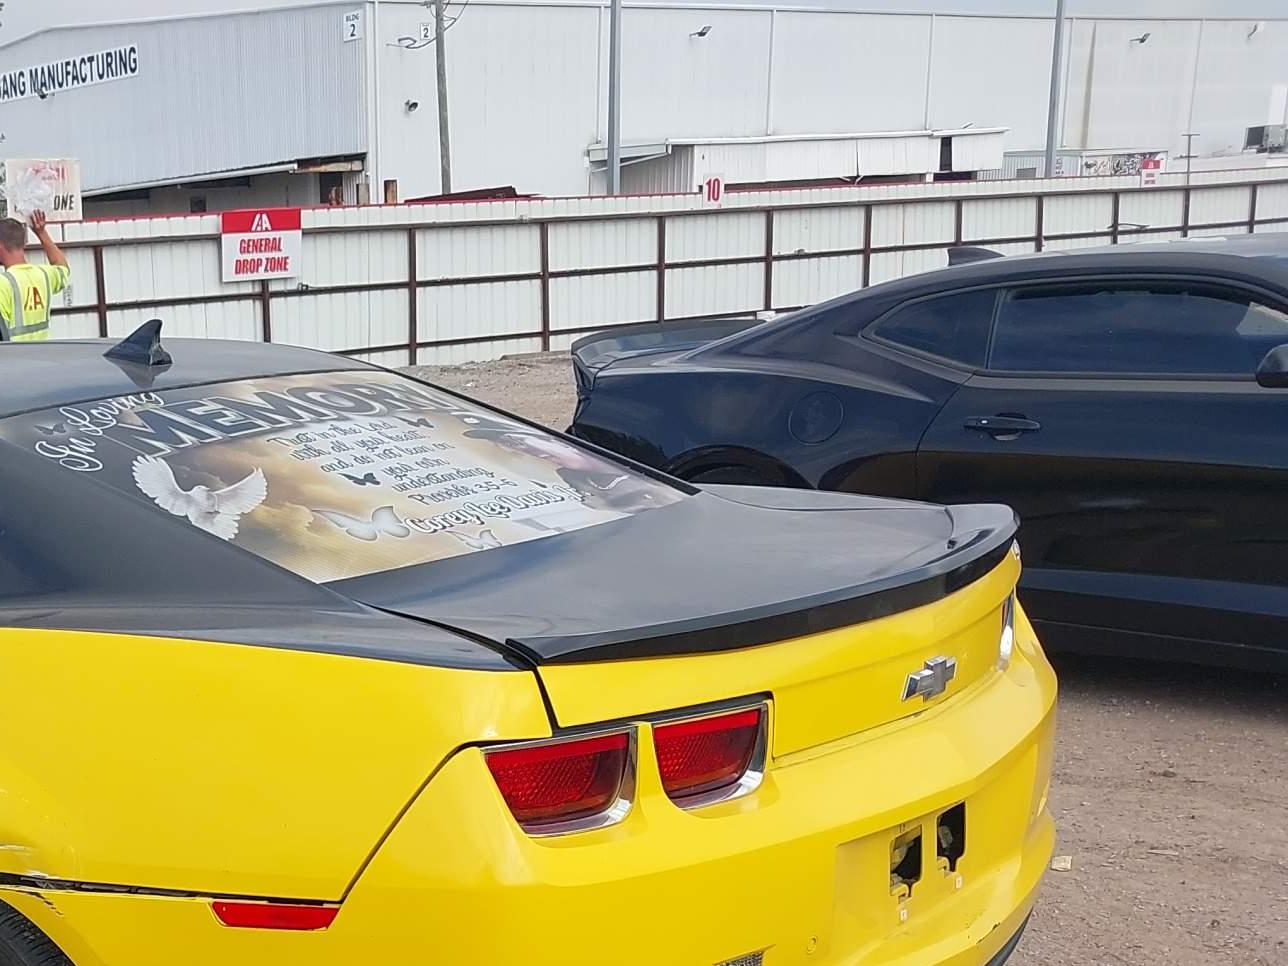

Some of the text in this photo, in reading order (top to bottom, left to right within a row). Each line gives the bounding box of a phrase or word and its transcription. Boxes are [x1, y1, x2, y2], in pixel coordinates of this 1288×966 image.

[350, 24, 356, 37] 2
[423, 27, 429, 38] 2
[28, 46, 139, 94] MANUFACTURING
[705, 177, 721, 202] 10
[239, 237, 282, 254] GENERAL
[235, 256, 289, 275] DROP ZONE
[35, 391, 165, 472] In Loving
[105, 384, 459, 459] MEMORY
[266, 432, 316, 447] Trust
[328, 424, 362, 437] the
[353, 421, 398, 432] Lord
[290, 444, 331, 460] with
[330, 440, 355, 453] all
[354, 436, 390, 452] your
[320, 442, 456, 473] and do not lean on
[380, 457, 451, 481] your own
[392, 467, 495, 492] understanding
[407, 483, 479, 506] Proverbs
[405, 506, 485, 534] Corey
[463, 500, 511, 519] Lee
